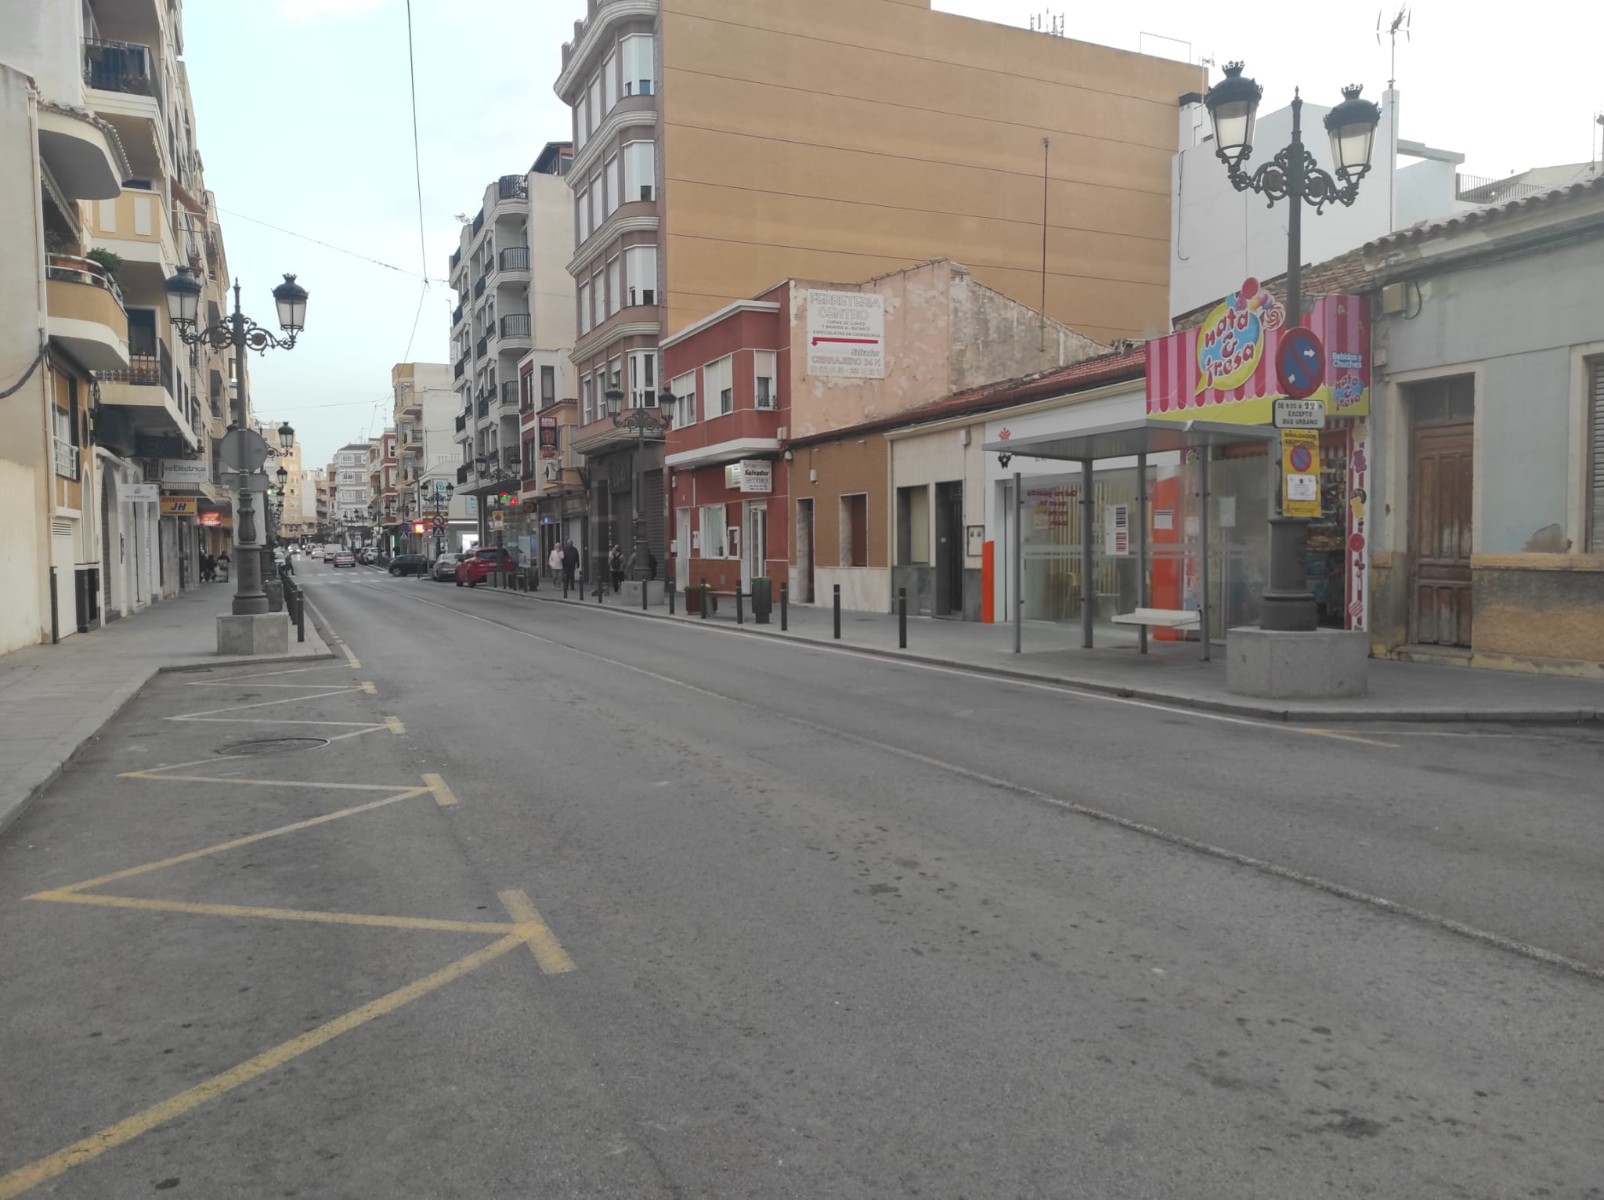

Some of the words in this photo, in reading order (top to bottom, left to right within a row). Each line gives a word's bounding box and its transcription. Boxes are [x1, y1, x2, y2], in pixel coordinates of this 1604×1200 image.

[818, 307, 869, 320] CENTRO
[1203, 307, 1250, 347] nata
[1205, 342, 1254, 389] fresa
